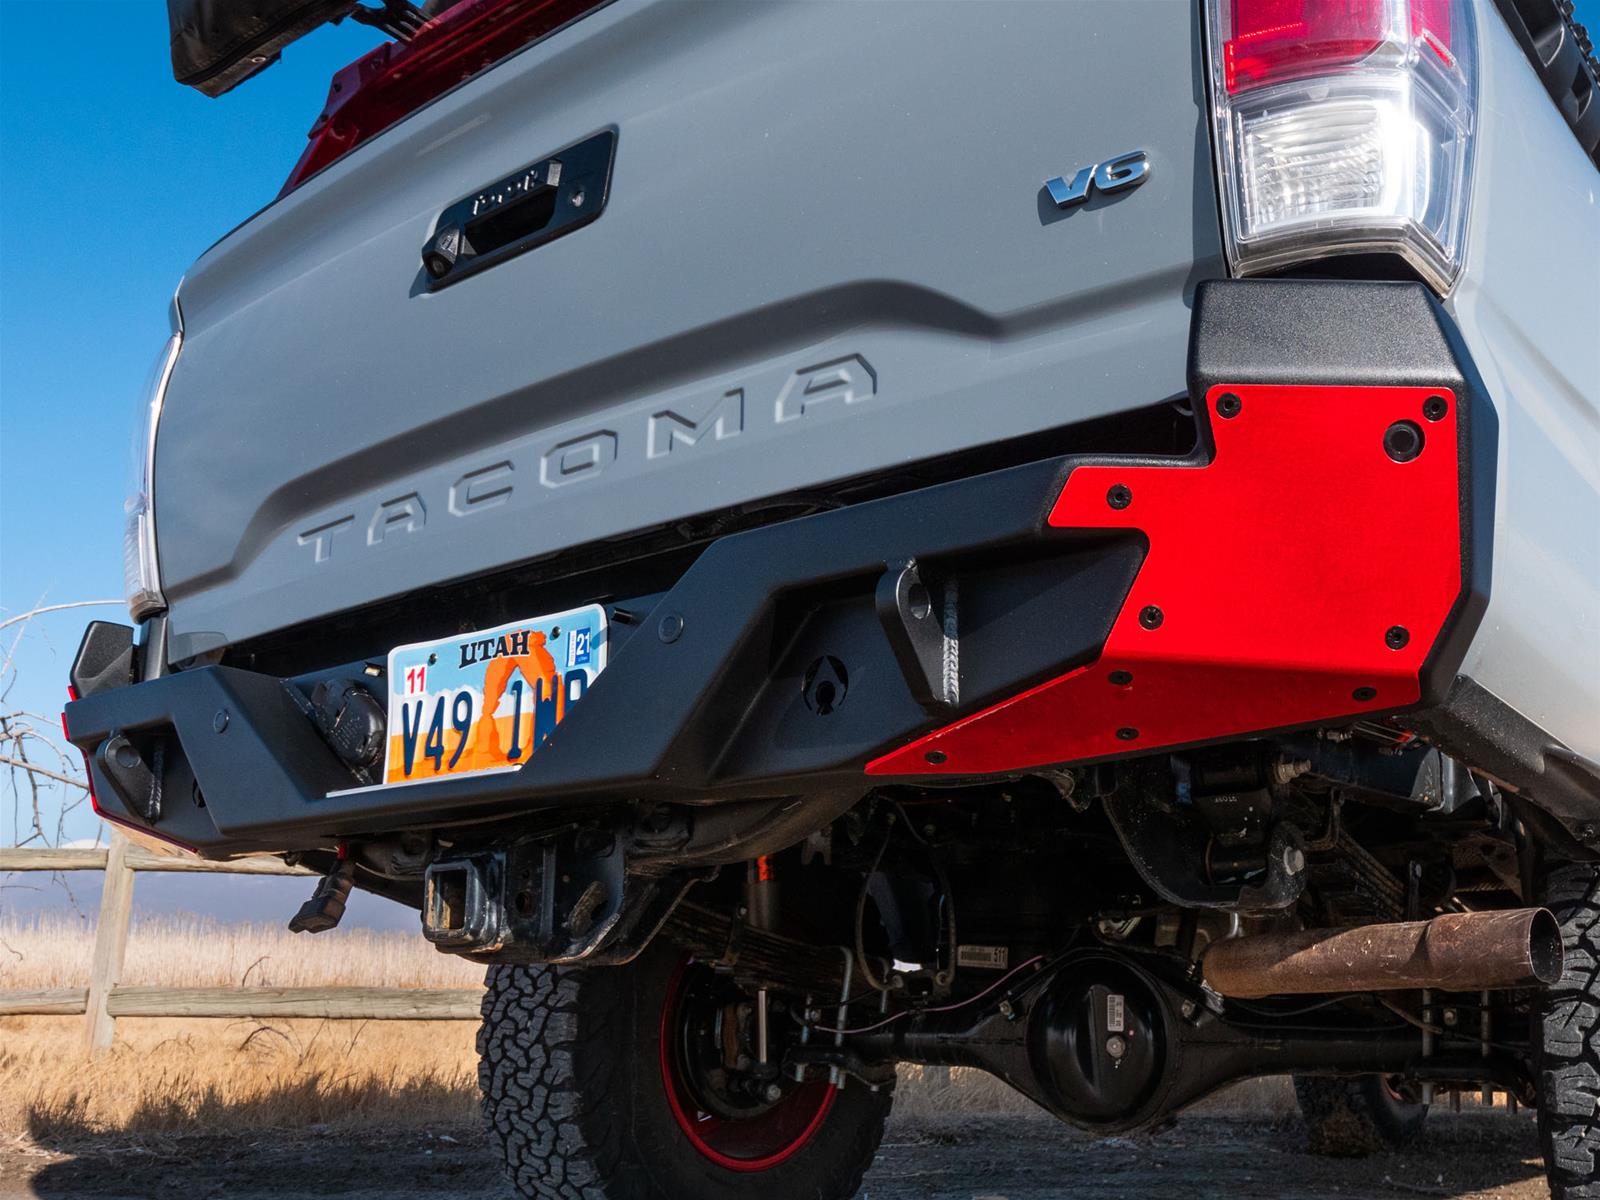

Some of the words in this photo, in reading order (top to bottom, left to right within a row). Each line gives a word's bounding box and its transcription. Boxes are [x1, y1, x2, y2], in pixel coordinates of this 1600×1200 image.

[1045, 150, 1149, 209] V6
[297, 352, 878, 563] TACOMA
[459, 630, 531, 668] UTAH
[576, 632, 590, 656] 21
[406, 666, 425, 694] 11
[402, 691, 473, 776] V49
